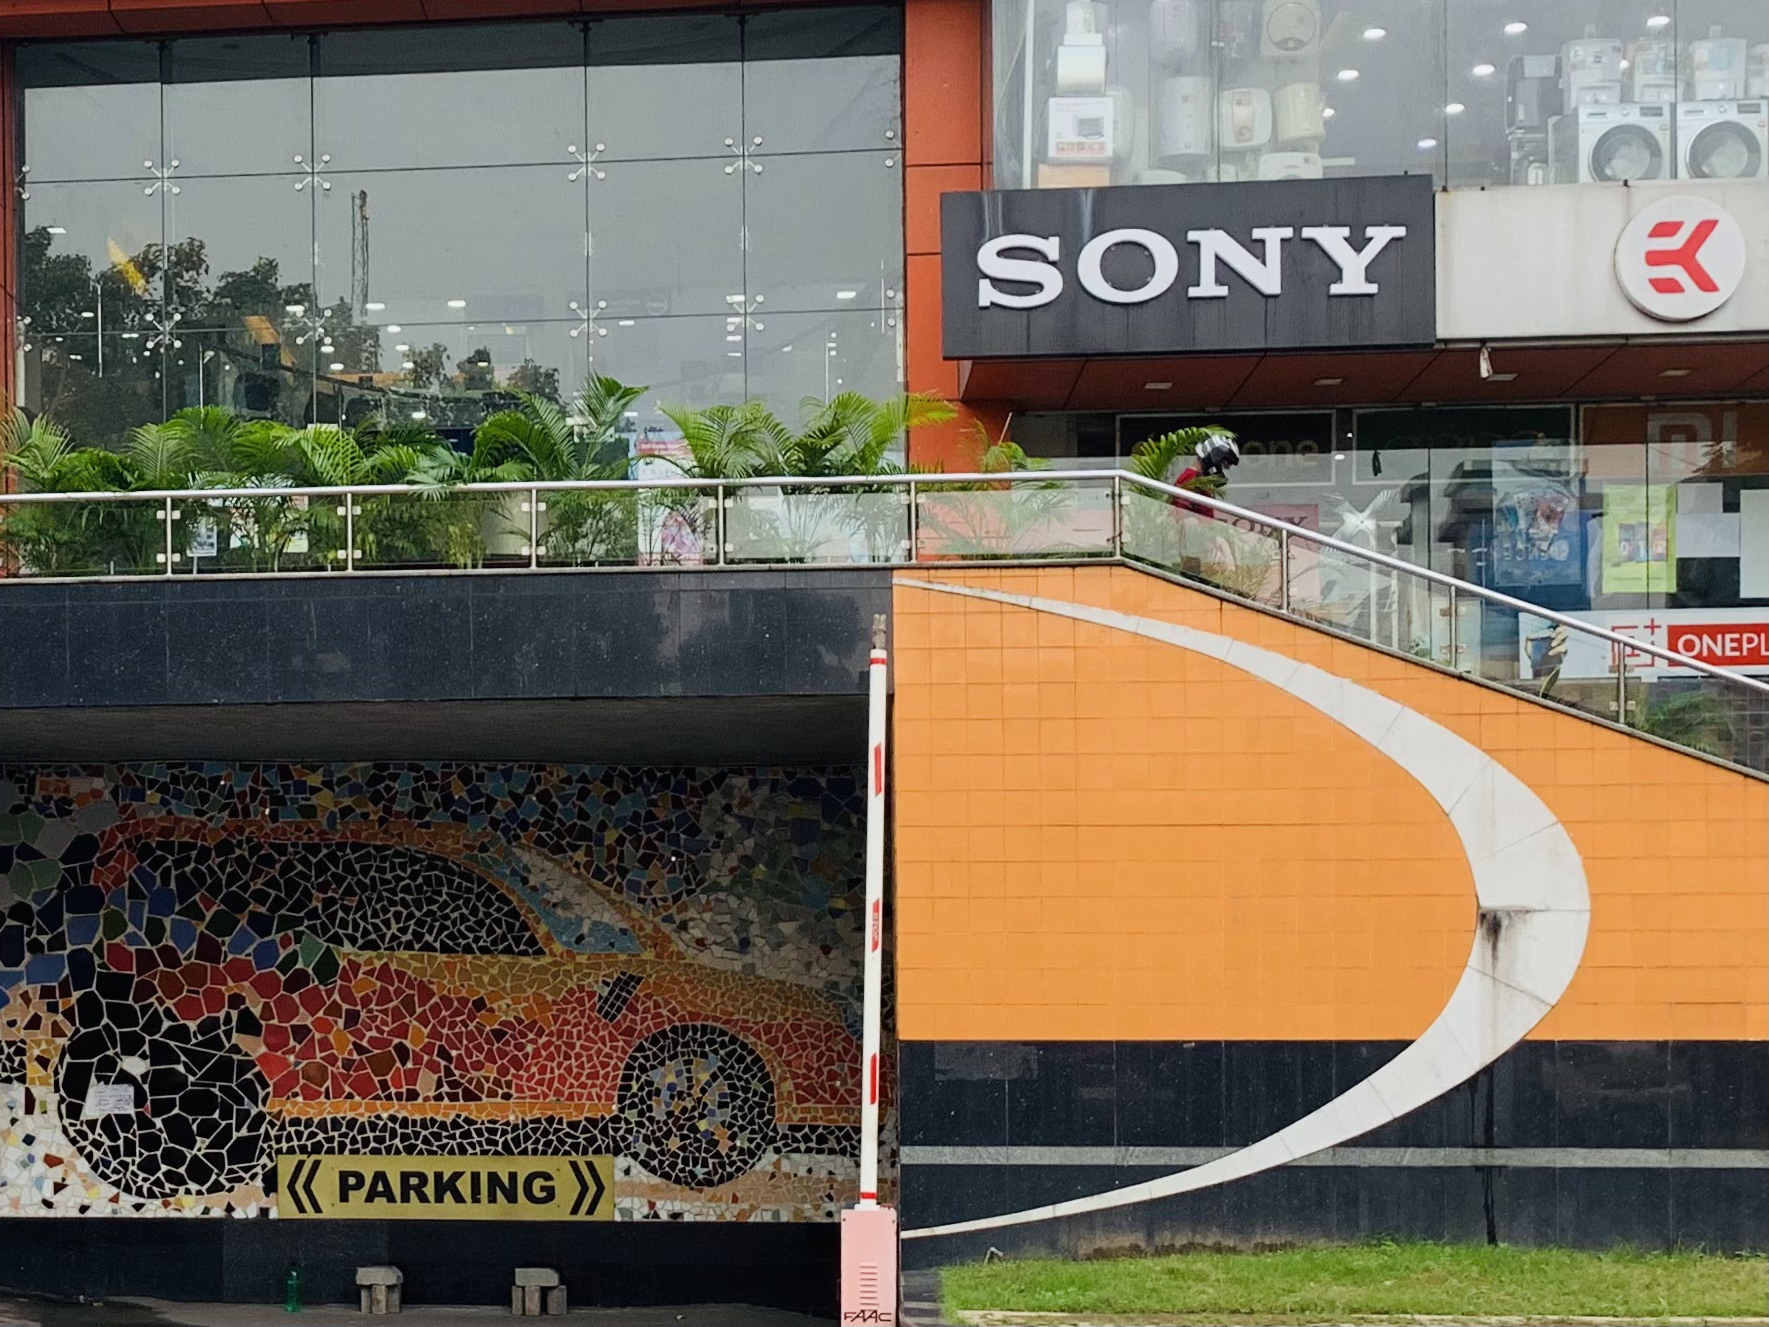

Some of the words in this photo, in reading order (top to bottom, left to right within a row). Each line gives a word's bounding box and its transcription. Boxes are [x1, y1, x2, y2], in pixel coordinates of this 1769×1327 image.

[975, 224, 1407, 309] SONY
[1677, 632, 1769, 658] ONEPL
[337, 1169, 557, 1206] PARKING
[843, 1309, 892, 1323] FAAC
